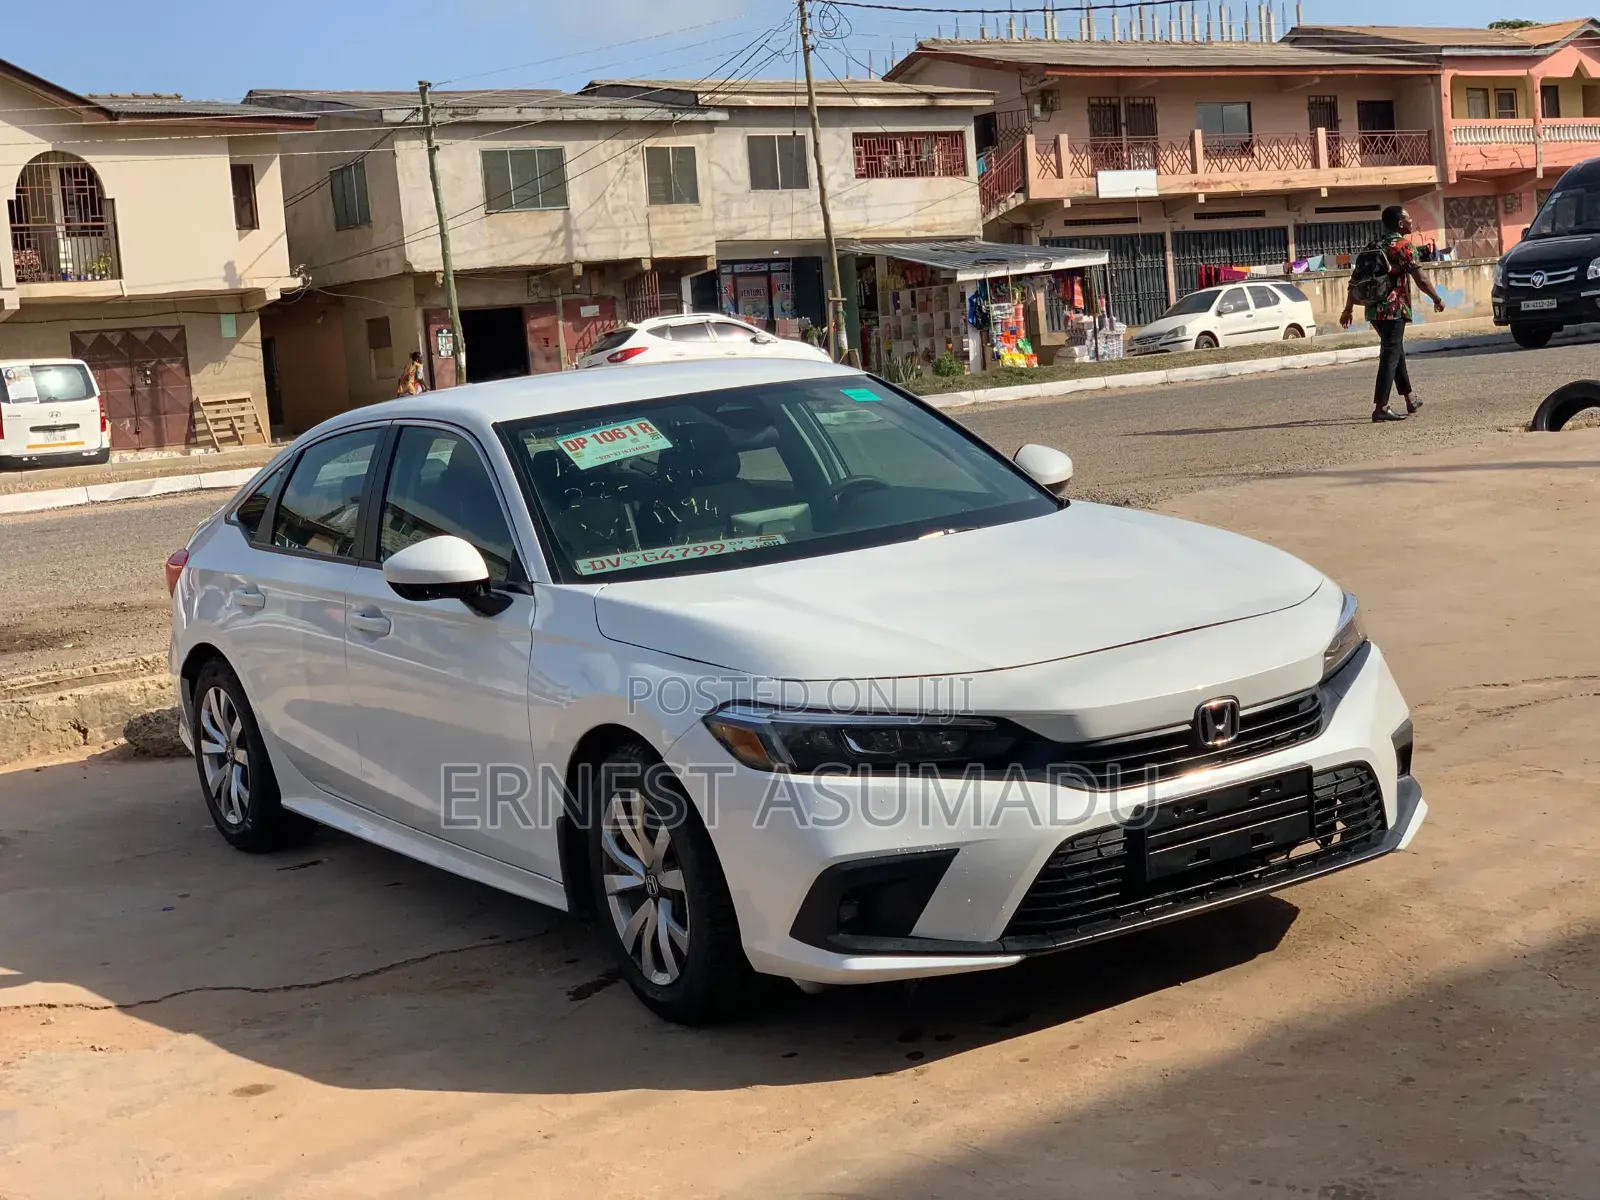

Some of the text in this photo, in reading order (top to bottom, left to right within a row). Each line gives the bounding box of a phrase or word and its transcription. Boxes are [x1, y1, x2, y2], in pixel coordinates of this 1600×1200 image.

[740, 288, 766, 298] VENTURES
[562, 422, 655, 452] DP 1061 R
[588, 543, 726, 571] DV G4799
